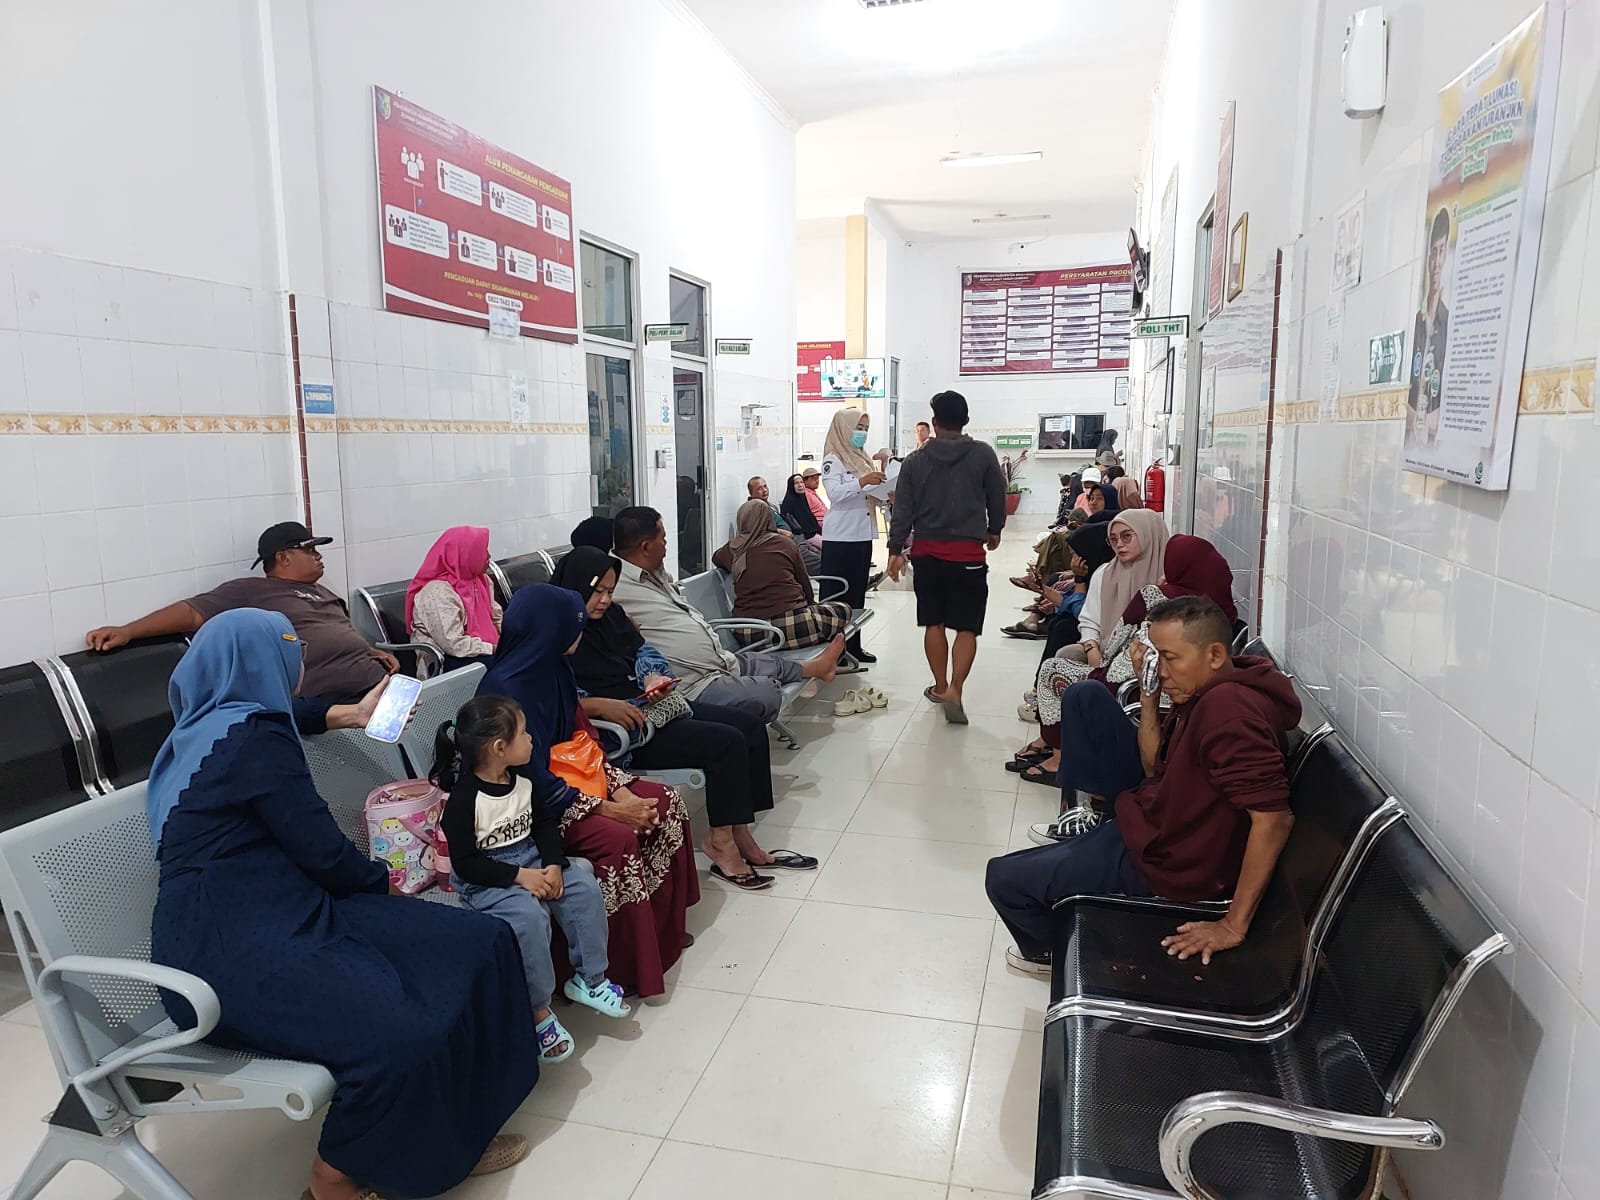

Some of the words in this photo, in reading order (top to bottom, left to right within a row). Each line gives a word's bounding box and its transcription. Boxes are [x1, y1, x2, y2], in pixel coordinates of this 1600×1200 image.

[1488, 79, 1518, 107] LUNASI
[1505, 100, 1524, 119] JKN
[1060, 270, 1108, 279] PERSYARATAN
[1140, 325, 1161, 334] POLI
[1163, 323, 1181, 332] THT
